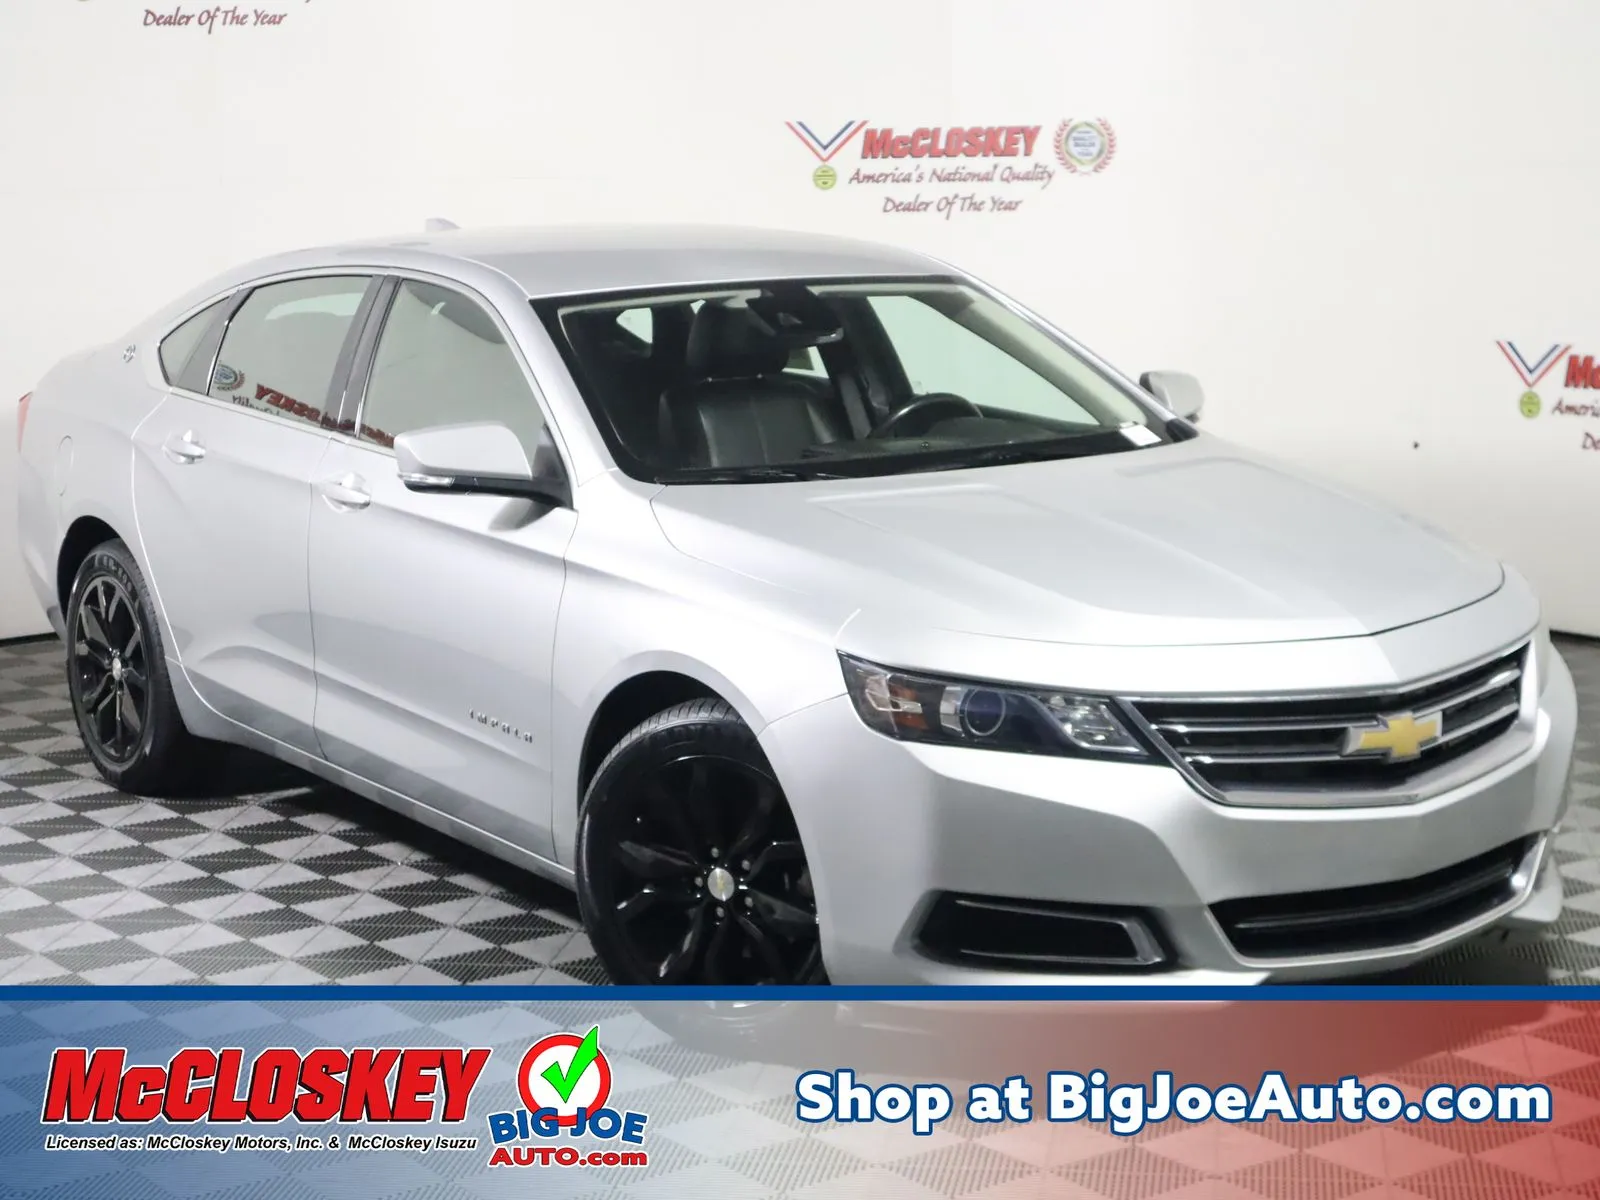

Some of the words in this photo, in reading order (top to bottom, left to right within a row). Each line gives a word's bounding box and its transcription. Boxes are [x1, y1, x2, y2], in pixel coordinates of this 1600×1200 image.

[142, 7, 195, 27] Dealer
[197, 5, 220, 35] Of
[221, 6, 248, 27] The
[252, 9, 288, 27] Year
[859, 124, 1042, 160] McCLOSKEY
[848, 164, 924, 185] America's
[928, 163, 998, 185] National
[999, 163, 1054, 190] Quality
[882, 194, 934, 214] Dealer
[936, 194, 959, 221] Of
[960, 193, 986, 213] The
[989, 196, 1023, 213] Year
